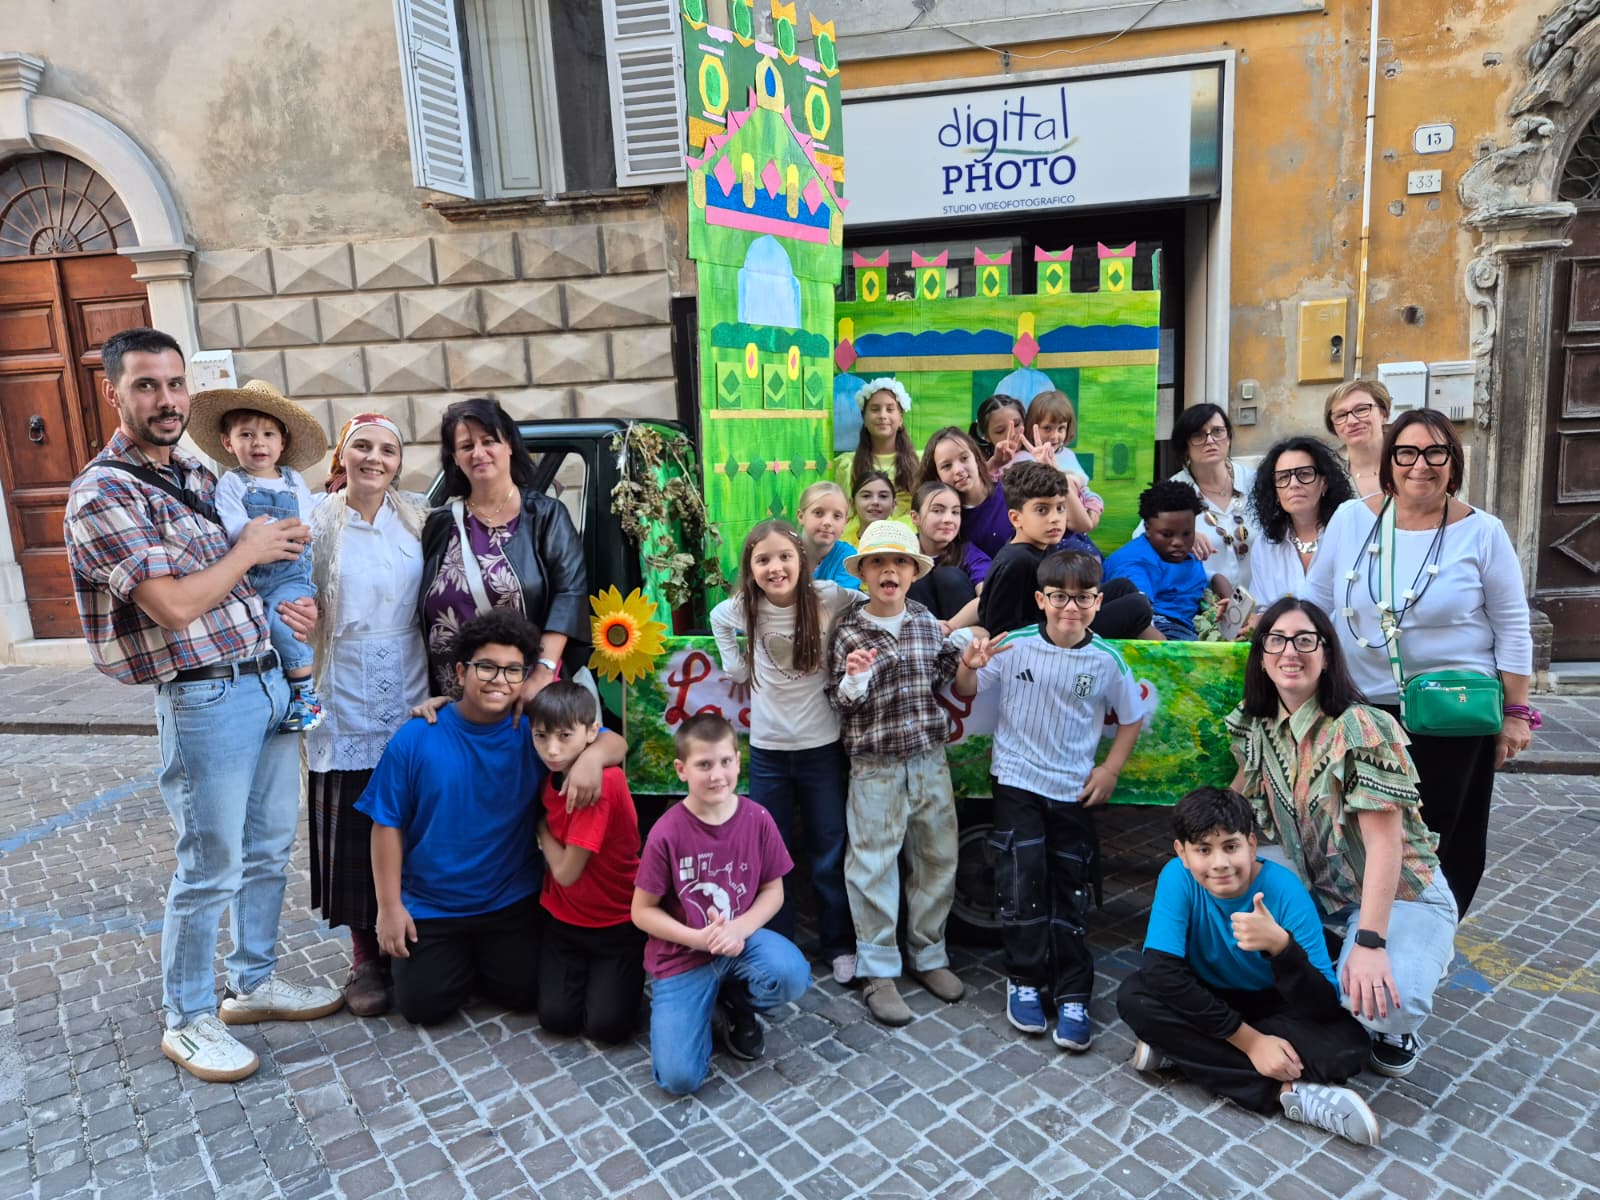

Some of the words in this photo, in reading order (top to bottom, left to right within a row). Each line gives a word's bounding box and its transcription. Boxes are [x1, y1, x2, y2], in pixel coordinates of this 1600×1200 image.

[938, 86, 1069, 163] digital
[941, 155, 1077, 195] PHOTO
[1416, 175, 1433, 189] 33
[943, 203, 977, 215] STUDIO
[978, 194, 1076, 211] VIDEOFOTOGRAFICO
